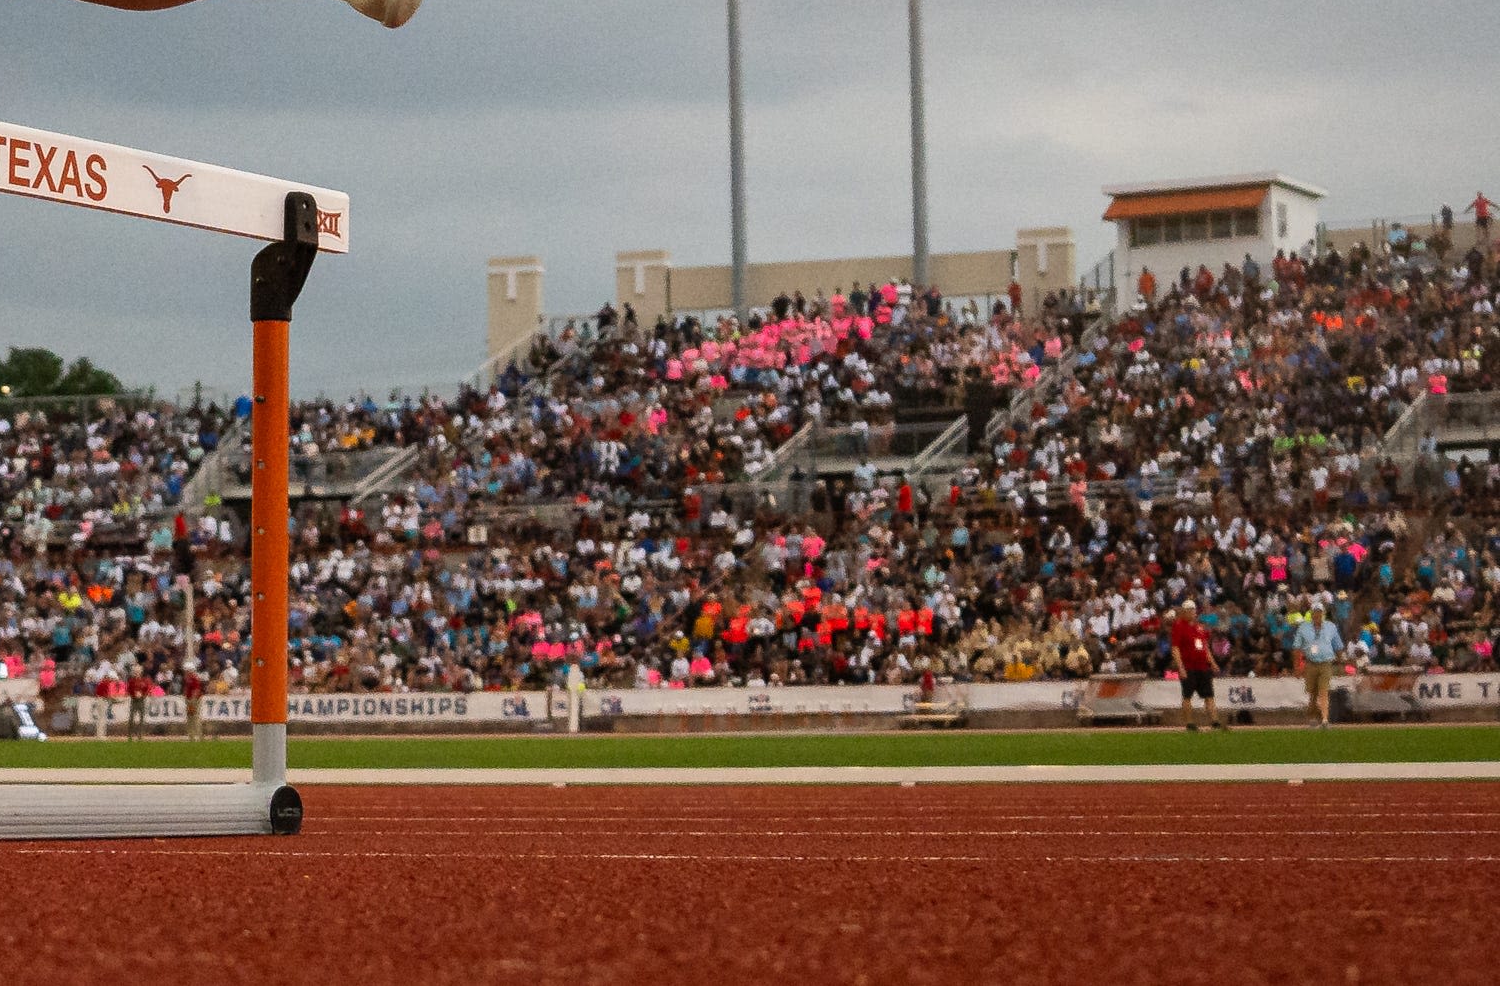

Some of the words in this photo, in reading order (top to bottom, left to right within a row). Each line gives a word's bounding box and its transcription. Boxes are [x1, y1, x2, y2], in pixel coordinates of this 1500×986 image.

[317, 208, 341, 238] XII
[150, 699, 183, 717] UIL
[288, 698, 468, 716] HAMPIONSHIPS
